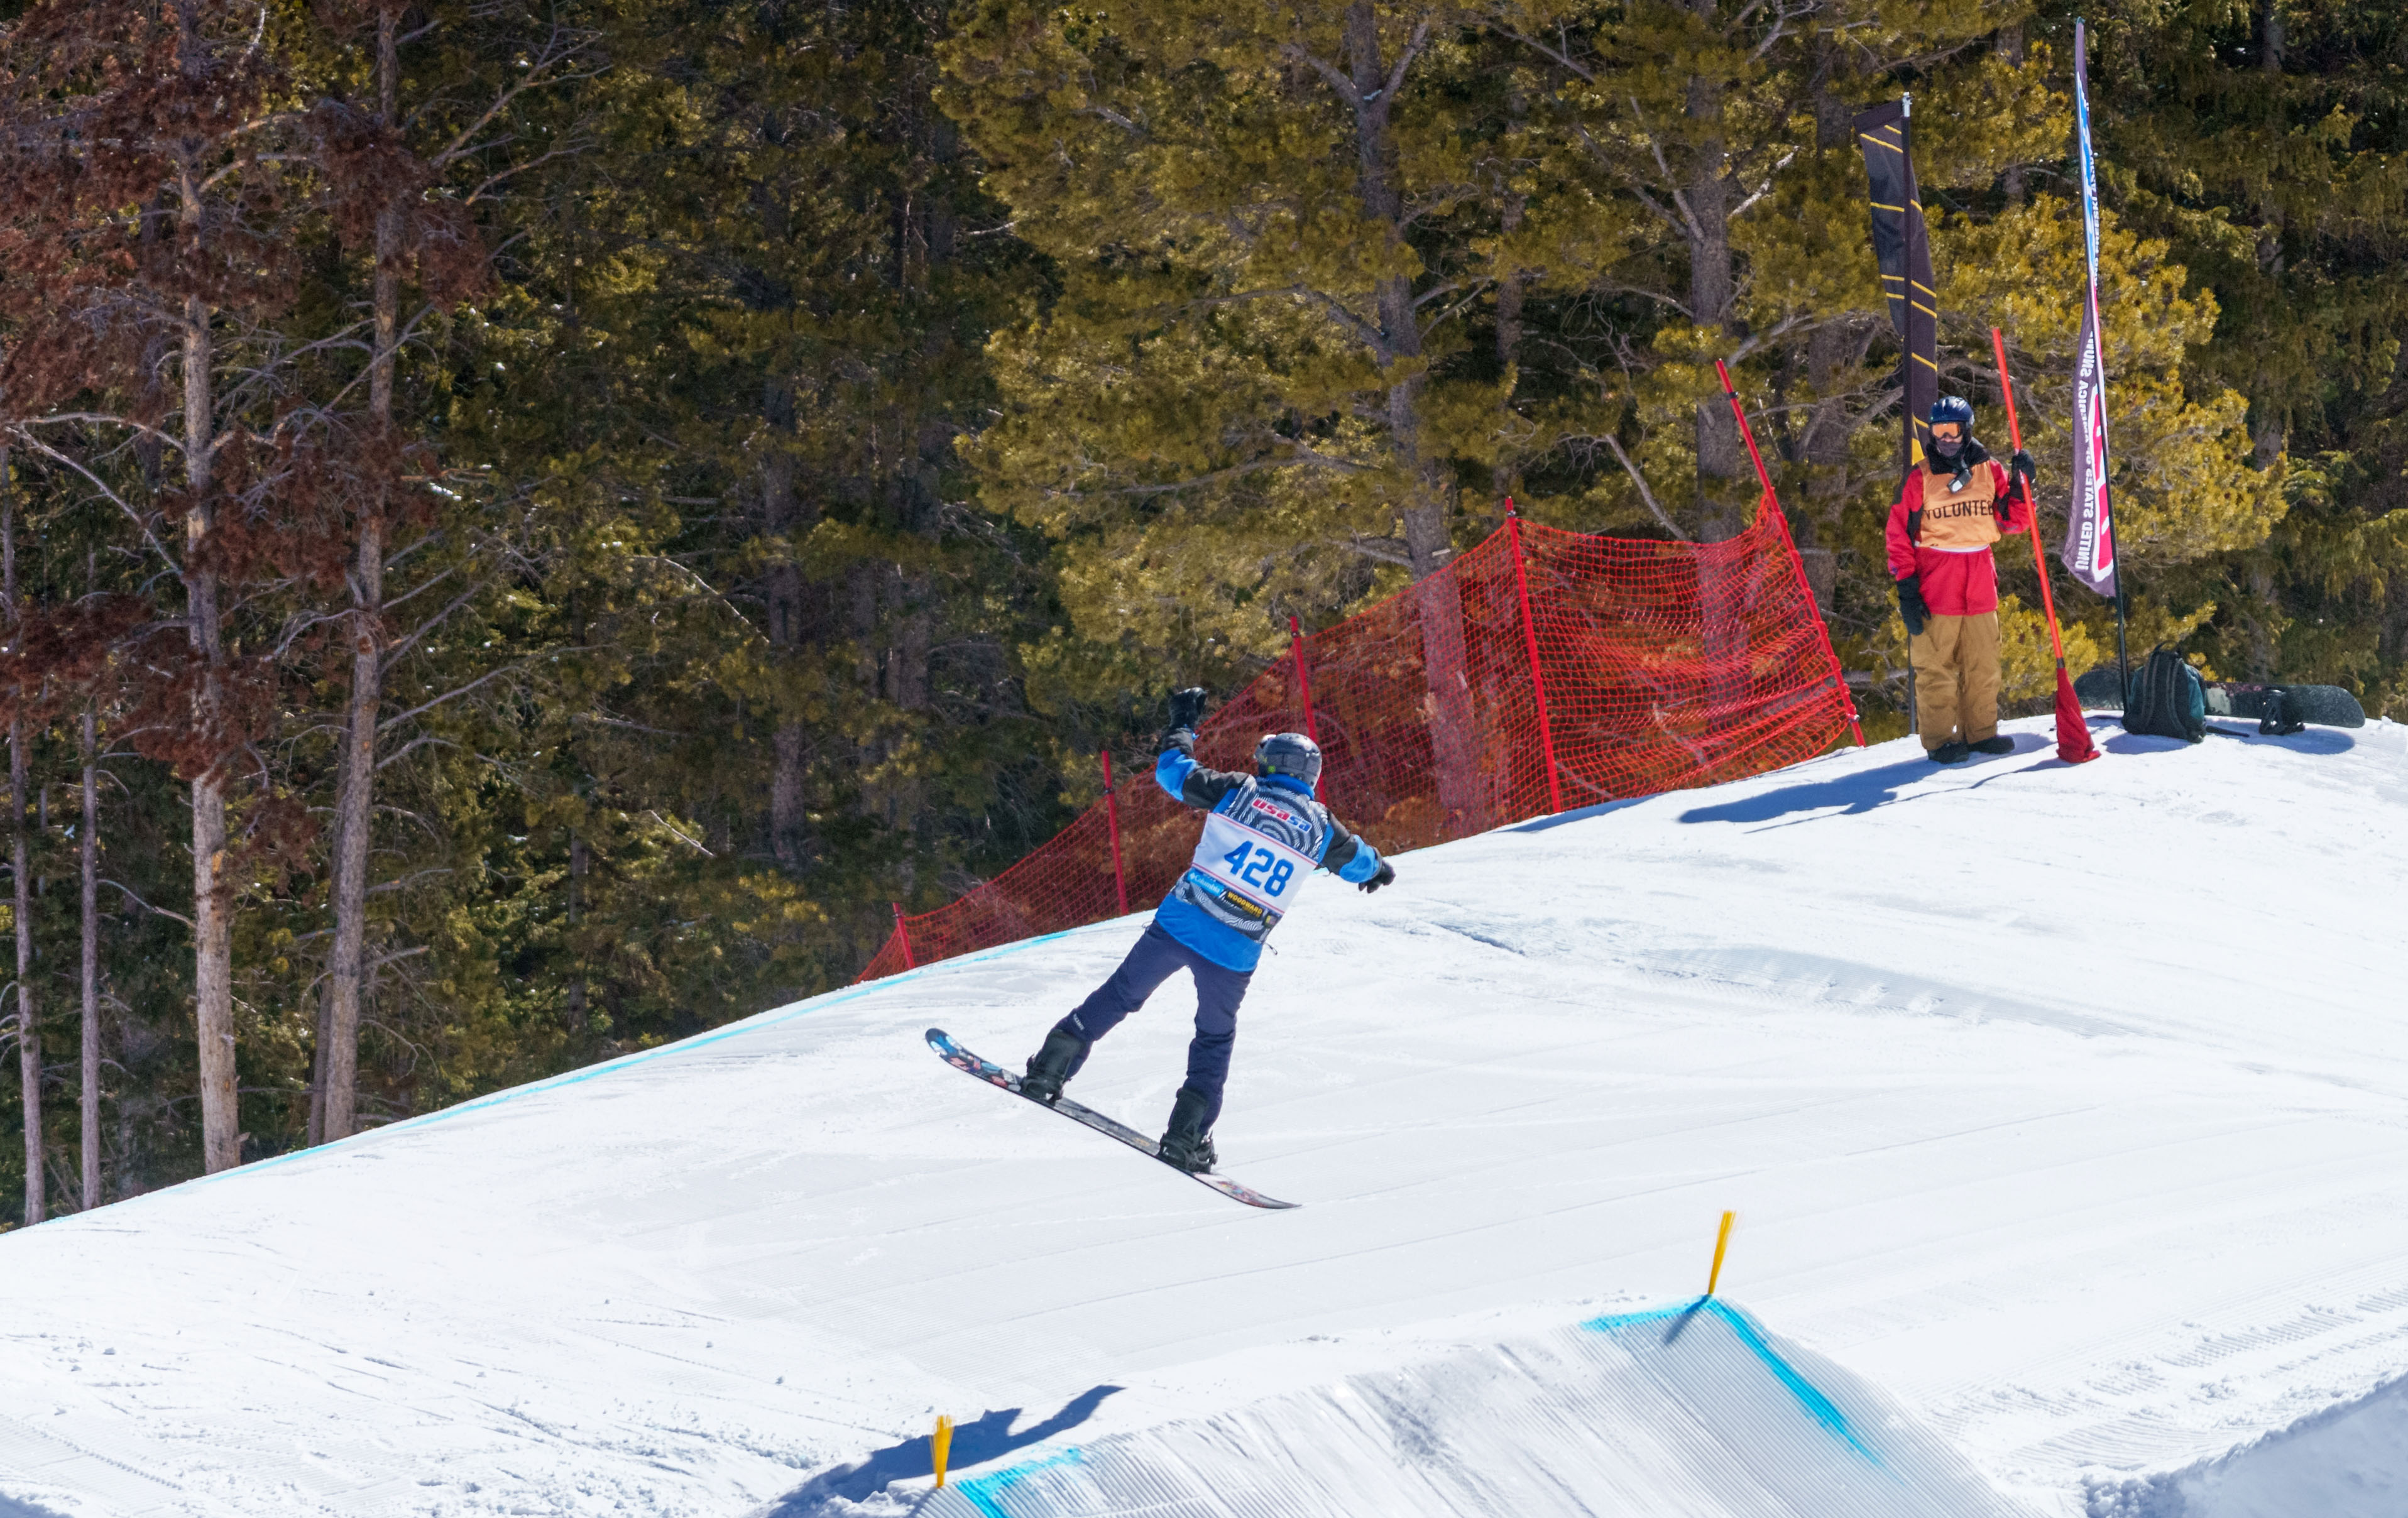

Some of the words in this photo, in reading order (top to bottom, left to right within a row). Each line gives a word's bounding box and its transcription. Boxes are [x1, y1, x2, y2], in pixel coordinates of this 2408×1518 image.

[1252, 798, 1312, 832] usasa
[1223, 840, 1294, 897] 428
[1195, 874, 1221, 893] Columbia
[1227, 891, 1263, 914] WOODWARD
